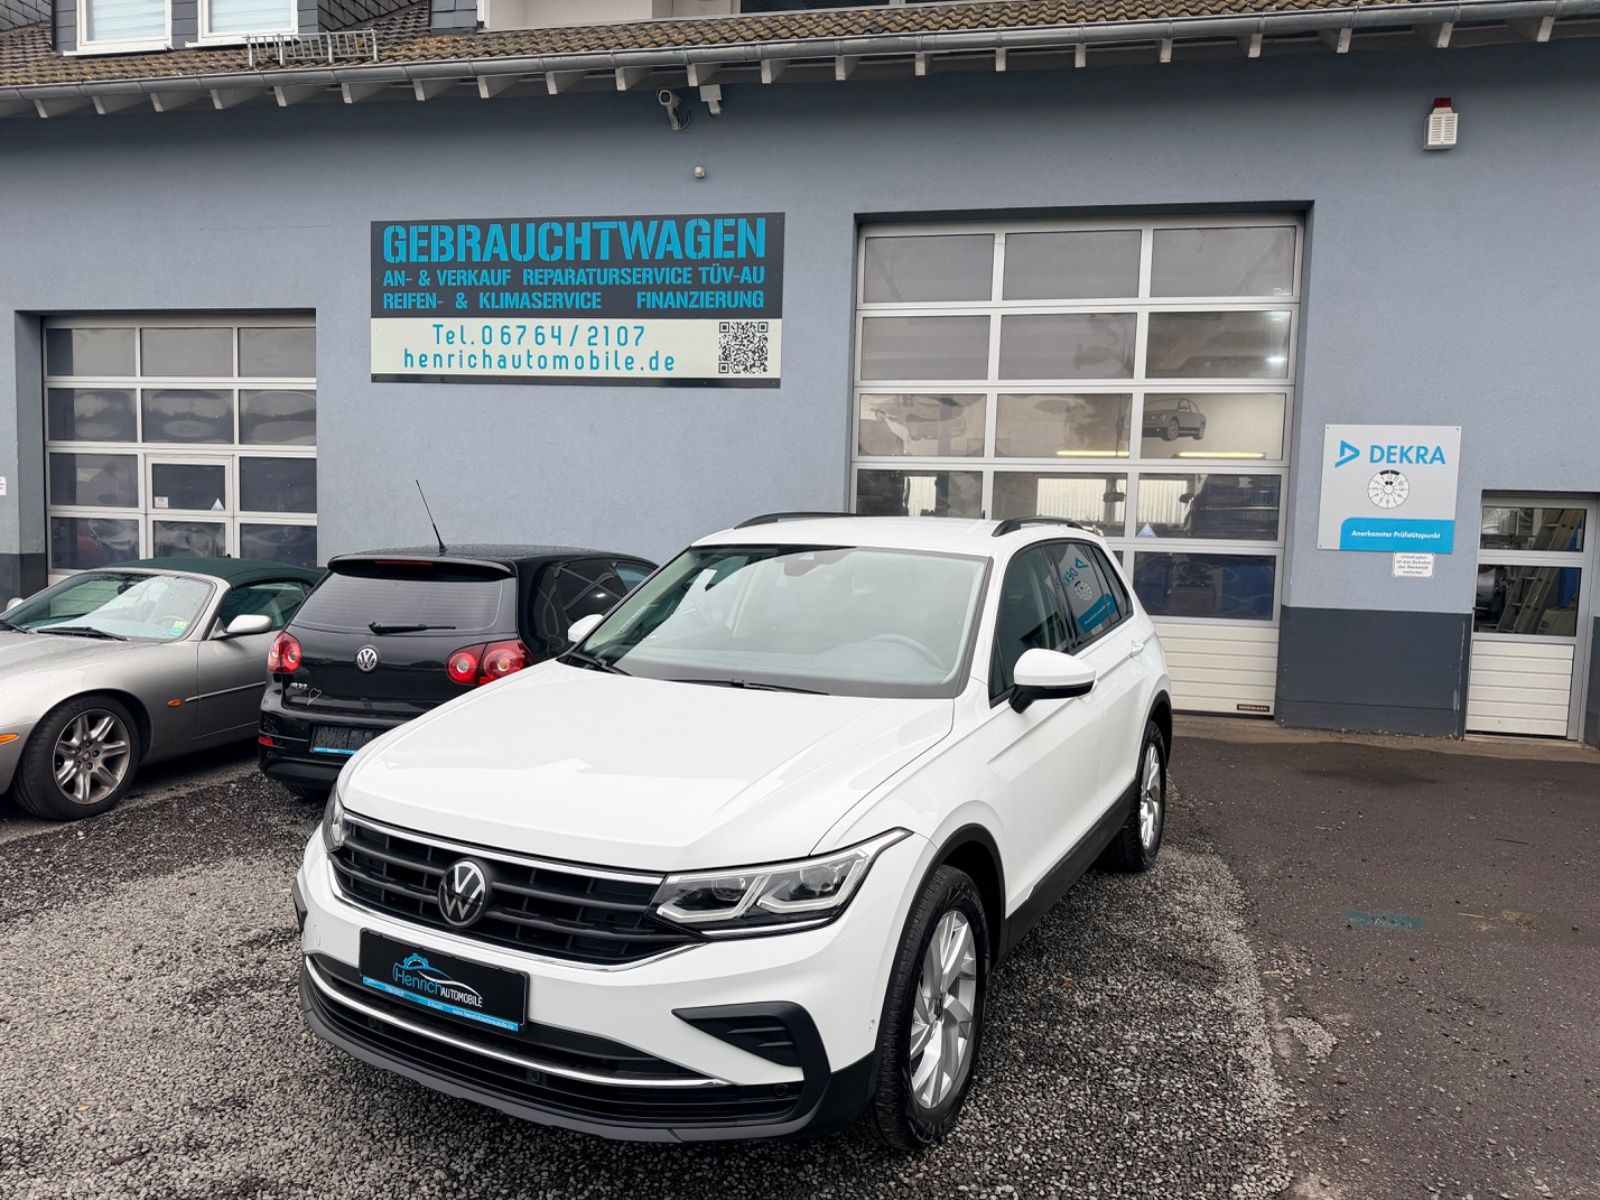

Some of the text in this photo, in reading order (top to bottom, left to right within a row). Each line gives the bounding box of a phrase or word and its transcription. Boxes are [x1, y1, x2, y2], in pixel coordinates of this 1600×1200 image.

[383, 217, 765, 263] GEBRAUCHTWAGEN
[383, 262, 765, 287] AN- & VERKAUF REPARATURSERVICE TÜV-AU
[383, 289, 765, 310] REIFEN- & KLIMASERVICE FINANZIERUNG
[404, 348, 675, 371] henrichautomobile.de
[1370, 445, 1445, 465] DEKRA
[394, 968, 441, 995] Henrich
[440, 987, 483, 1008] AUTOMOBILE
